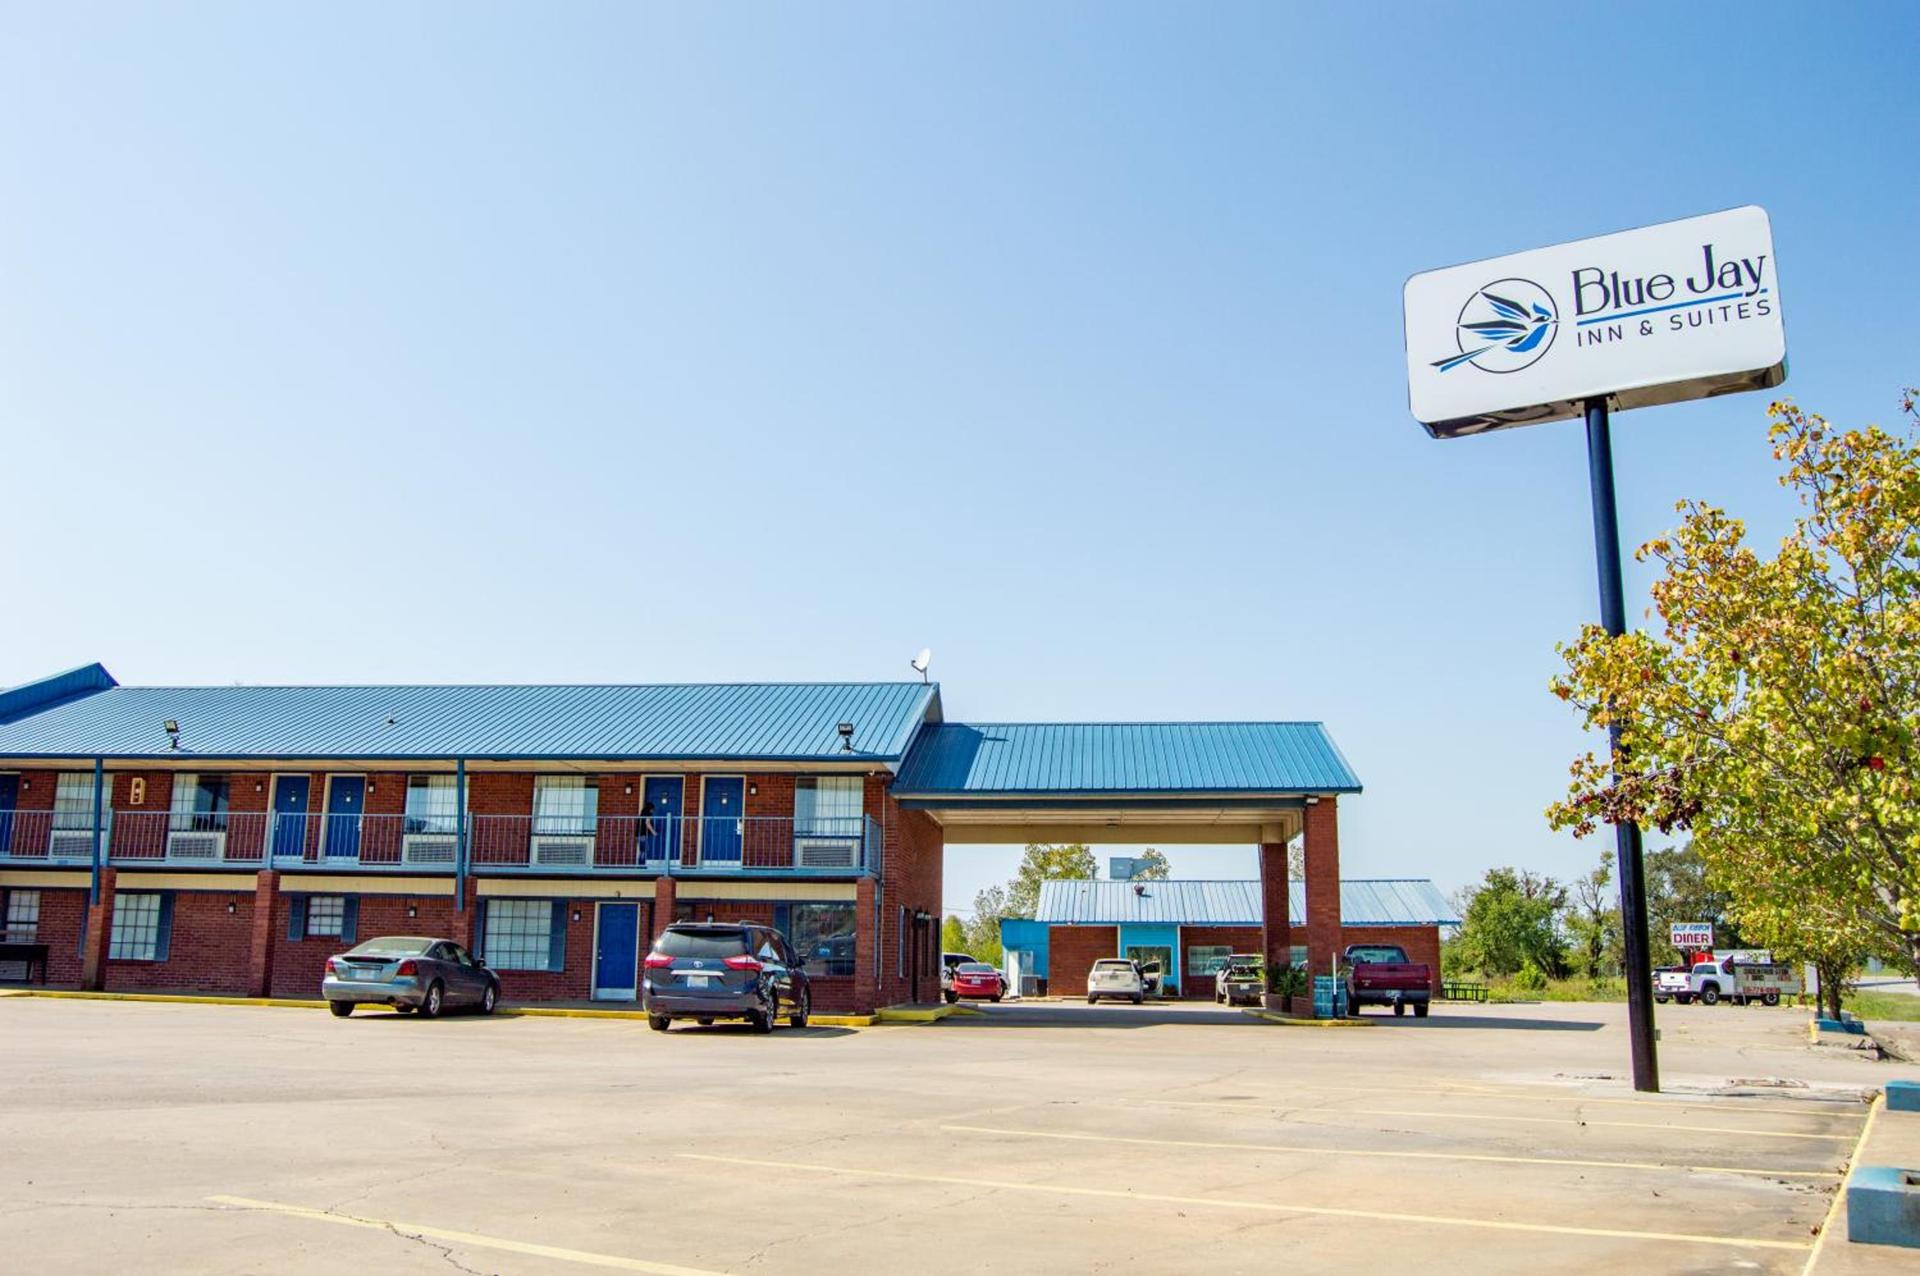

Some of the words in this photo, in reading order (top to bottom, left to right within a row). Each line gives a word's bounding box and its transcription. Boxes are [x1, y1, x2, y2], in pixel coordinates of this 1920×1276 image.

[1571, 266, 1676, 317] Blue
[1686, 243, 1768, 298] Jay
[1577, 324, 1623, 347] INN
[1639, 319, 1655, 336] &
[1669, 298, 1771, 331] SUITES
[1673, 933, 1709, 943] DINER
